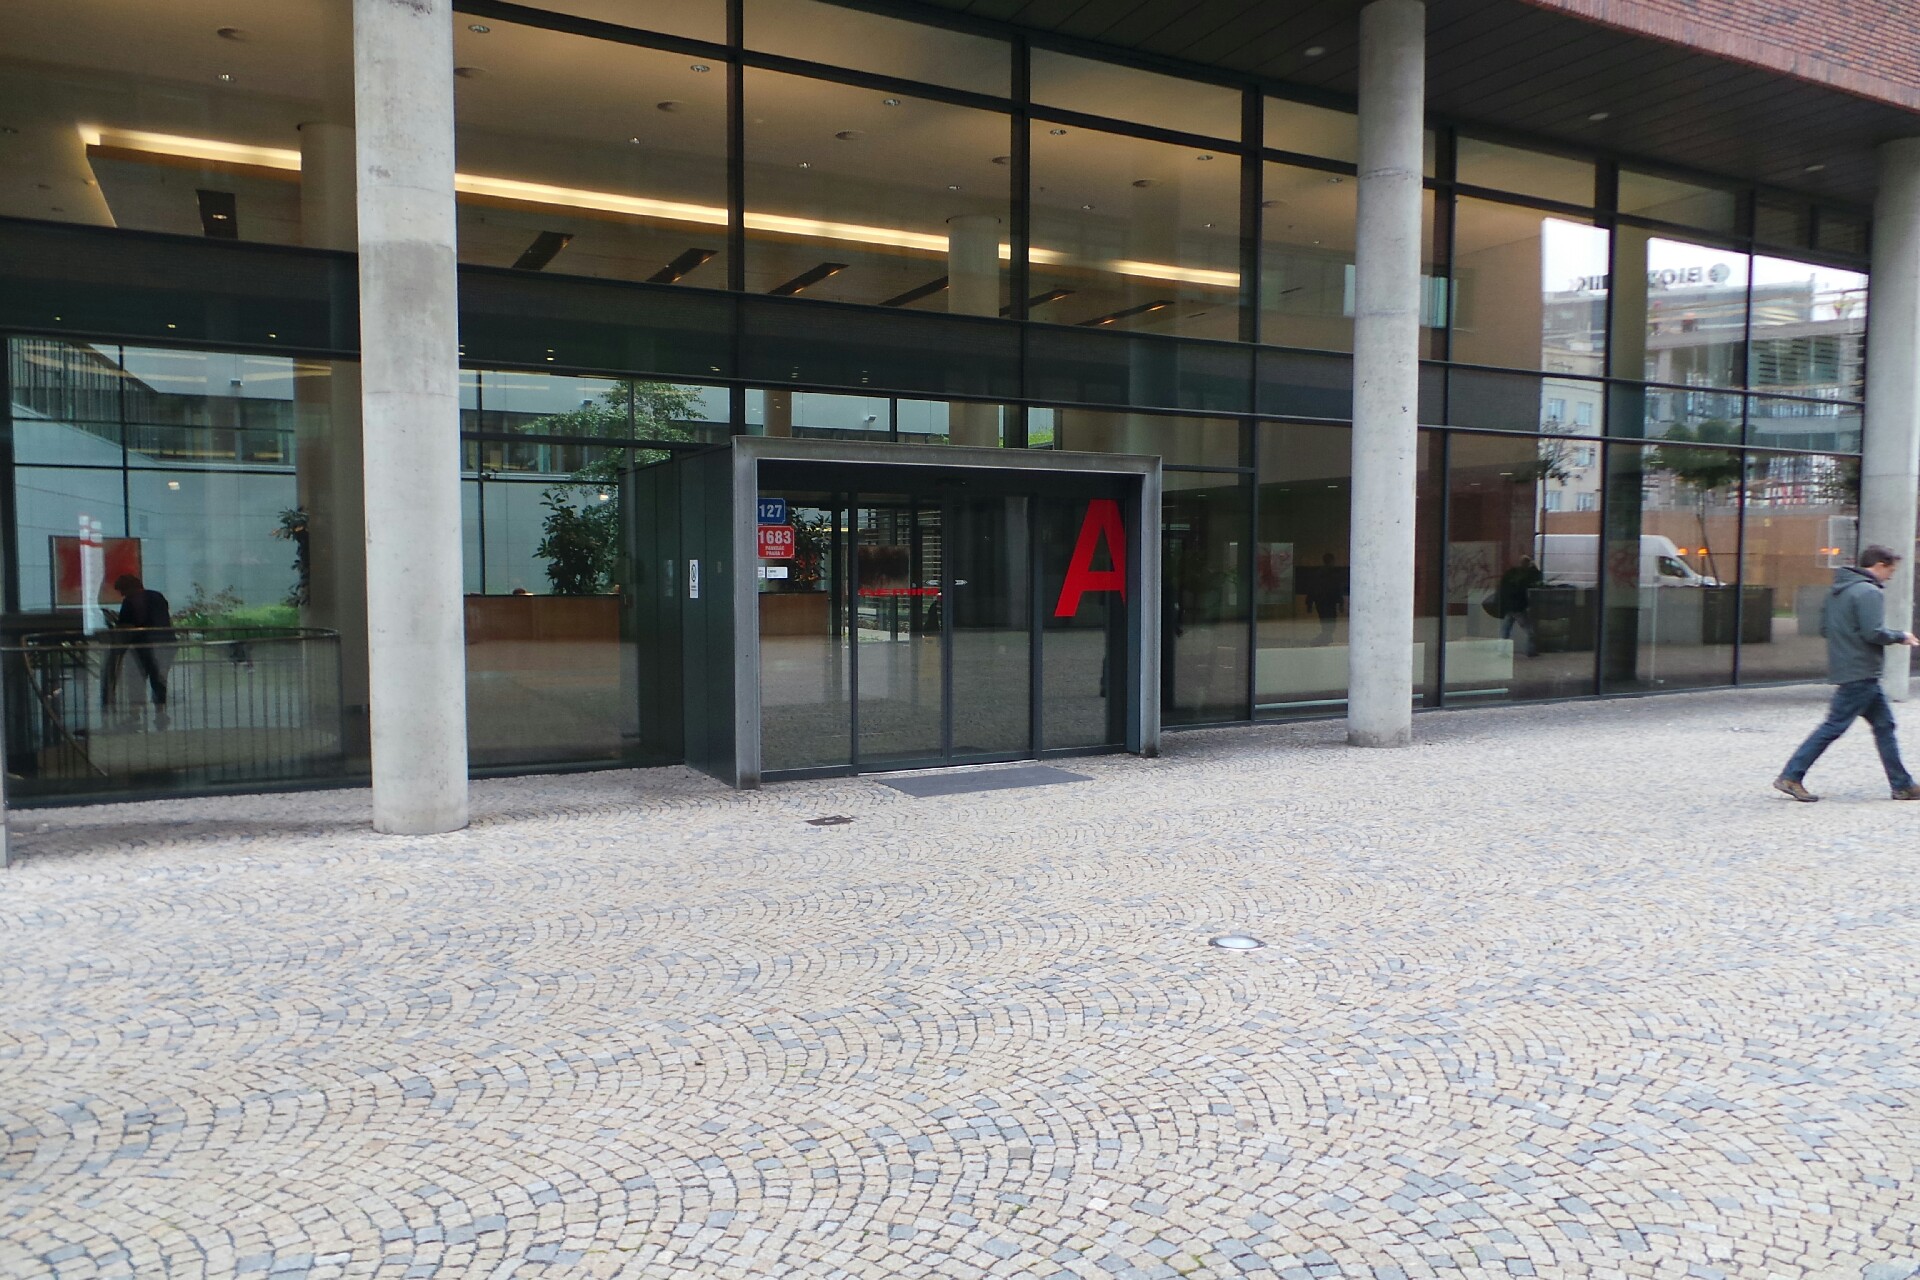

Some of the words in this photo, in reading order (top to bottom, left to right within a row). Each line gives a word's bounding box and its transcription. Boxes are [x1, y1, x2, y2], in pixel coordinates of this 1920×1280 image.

[759, 504, 782, 517] 127
[758, 530, 791, 544] 1683
[1055, 499, 1126, 617] A
